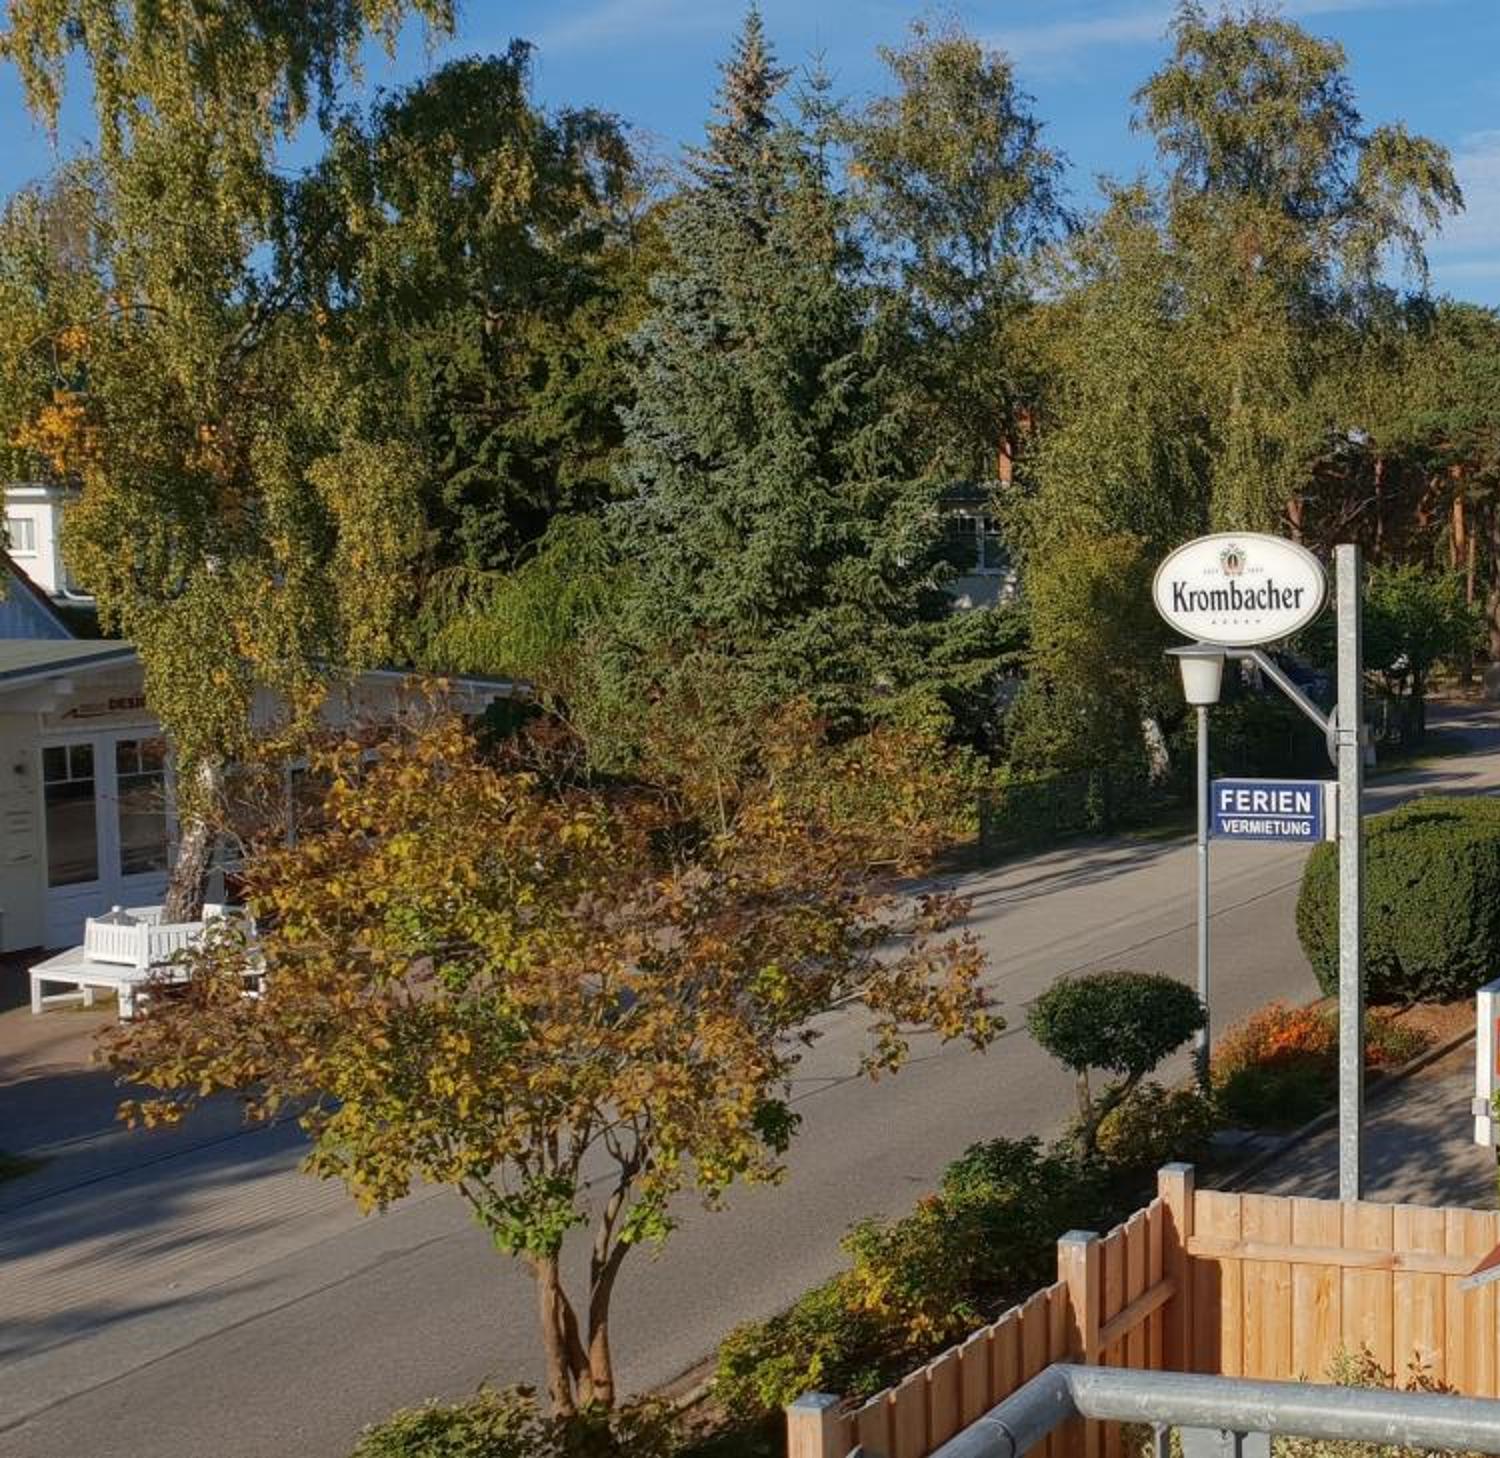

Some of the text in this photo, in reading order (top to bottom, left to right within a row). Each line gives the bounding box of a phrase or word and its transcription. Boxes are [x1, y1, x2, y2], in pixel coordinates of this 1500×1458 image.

[1172, 578, 1305, 613] Krombacher
[1220, 789, 1312, 813] FERIEN
[1221, 819, 1312, 836] VERMIETUNG
